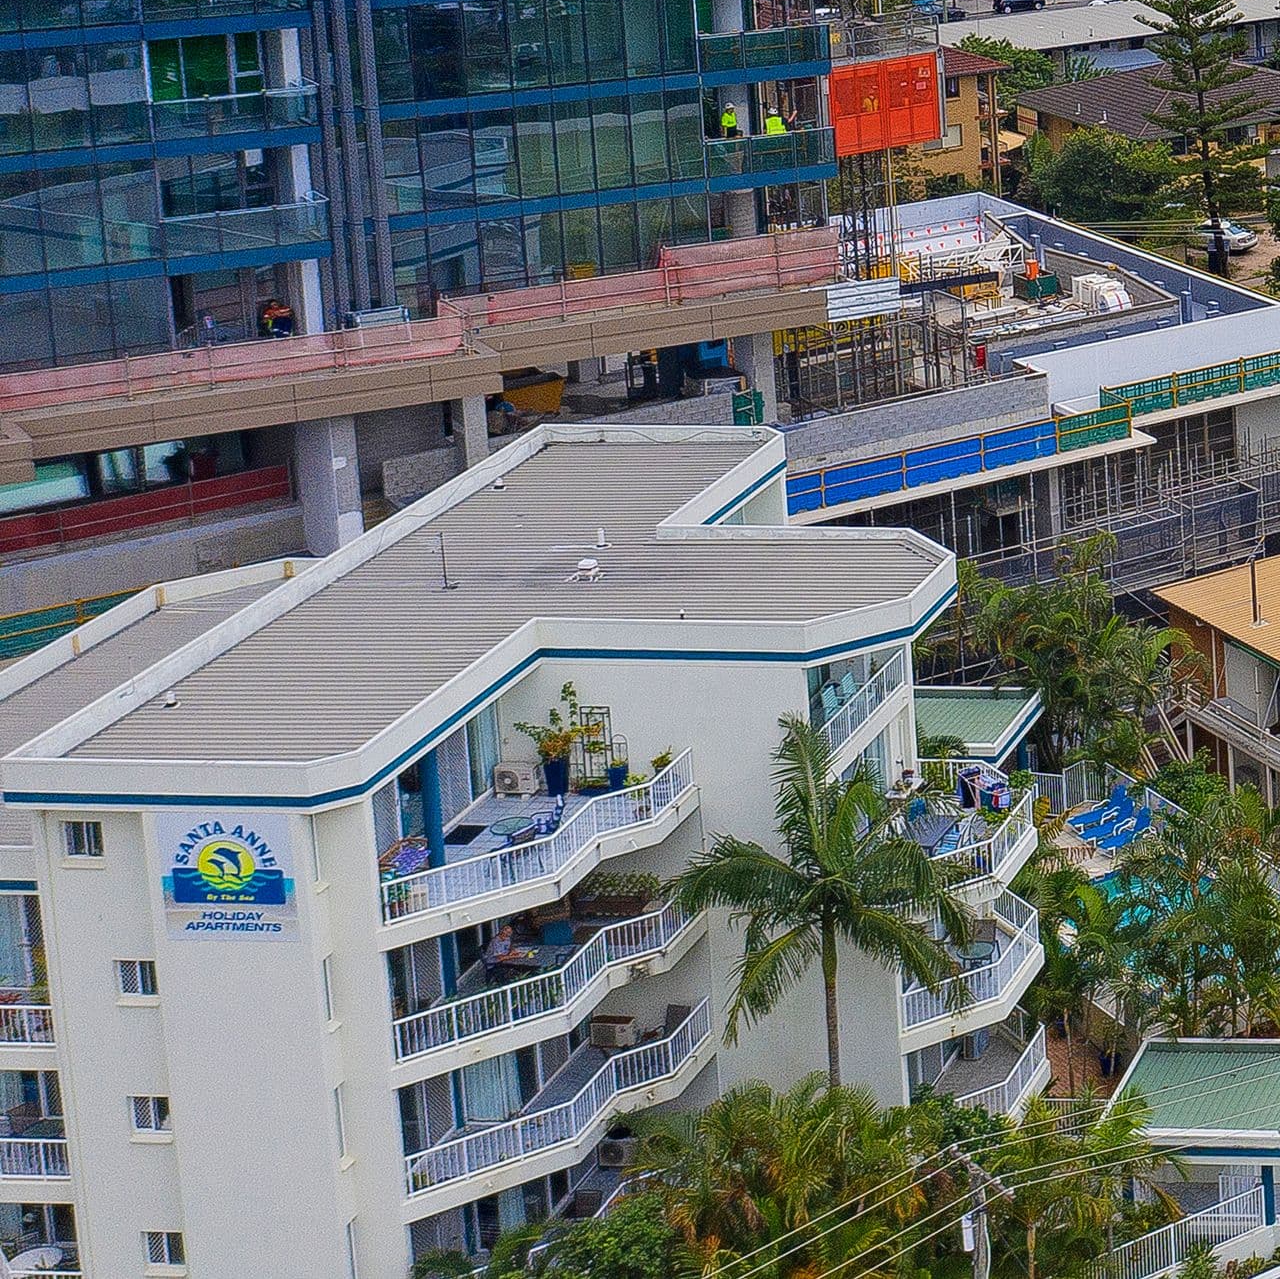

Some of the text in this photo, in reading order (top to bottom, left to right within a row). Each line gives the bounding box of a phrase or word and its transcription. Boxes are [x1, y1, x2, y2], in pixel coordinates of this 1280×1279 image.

[176, 821, 278, 868] SANTA ANNE
[202, 911, 265, 921] HOLIDAY
[185, 922, 282, 932] APARTMENTS
